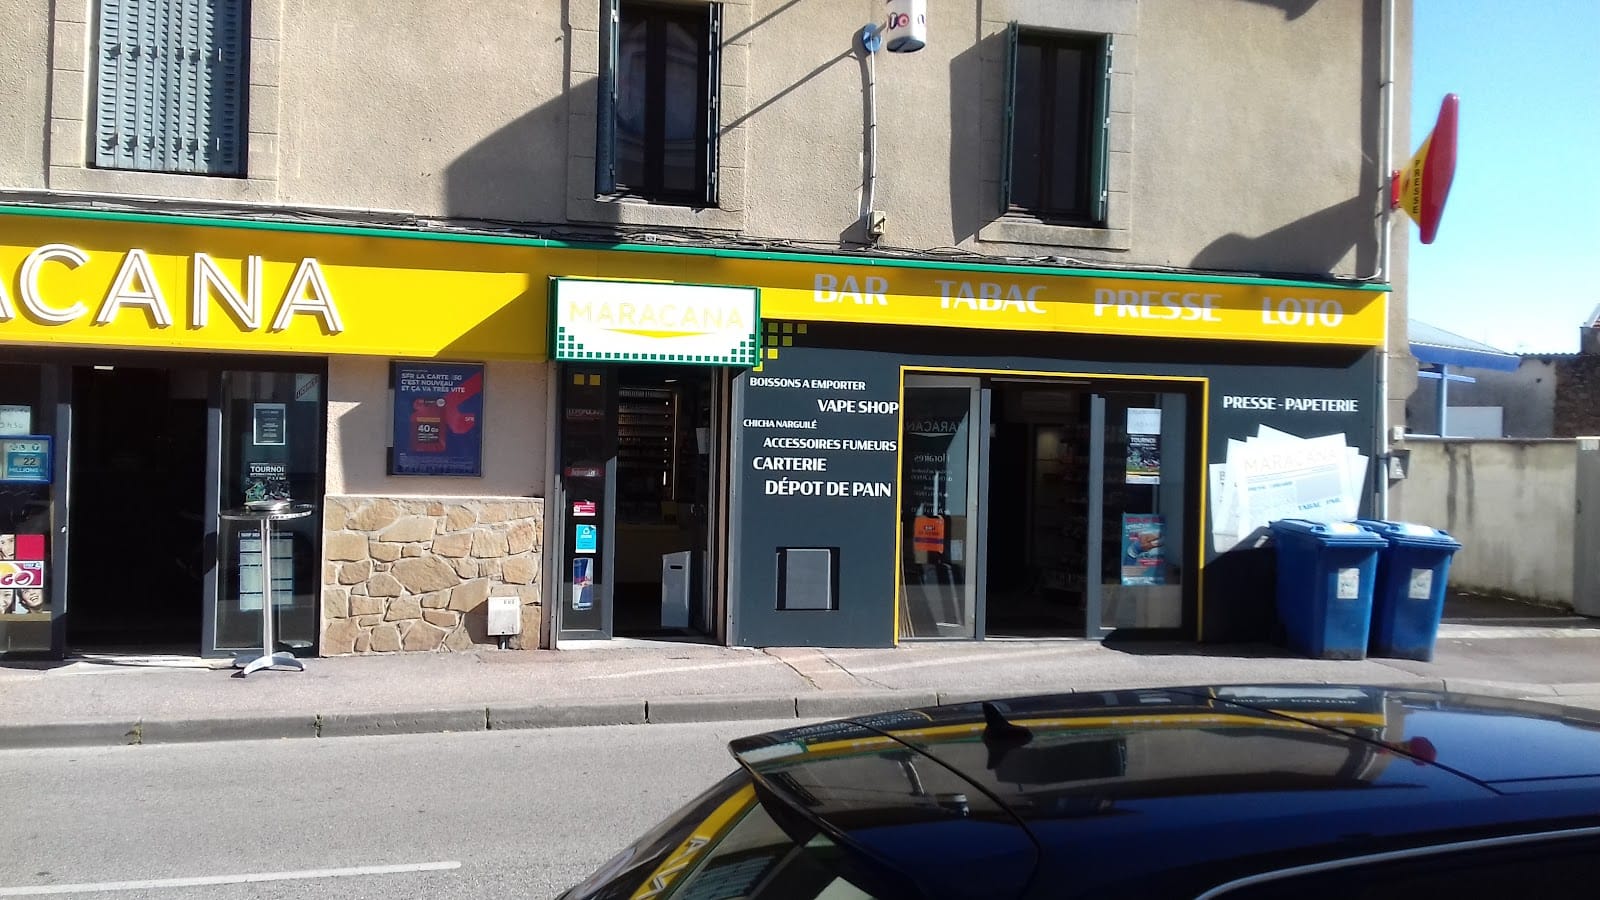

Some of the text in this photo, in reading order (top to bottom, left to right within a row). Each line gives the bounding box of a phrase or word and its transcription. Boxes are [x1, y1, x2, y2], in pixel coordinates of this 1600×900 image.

[1412, 159, 1420, 214] PRESSE
[0, 243, 343, 335] CANA
[813, 273, 1343, 327] BAR TABAC PRESSE LOTO
[569, 301, 744, 328] MARACANA
[749, 377, 866, 391] BOISSONS A EMPORTER
[817, 399, 899, 414] VAPE SHOP
[1223, 395, 1277, 410] PRESSE
[1285, 397, 1360, 412] PAPETERIE
[417, 424, 430, 433] 40
[743, 419, 818, 429] CHICHA NARGUILÉ
[763, 437, 897, 451] ACCESSOIRES FUMEURS
[23, 457, 36, 466] 22
[752, 457, 828, 471] CARTERIE
[765, 476, 892, 497] DÉPOT DE PAIN
